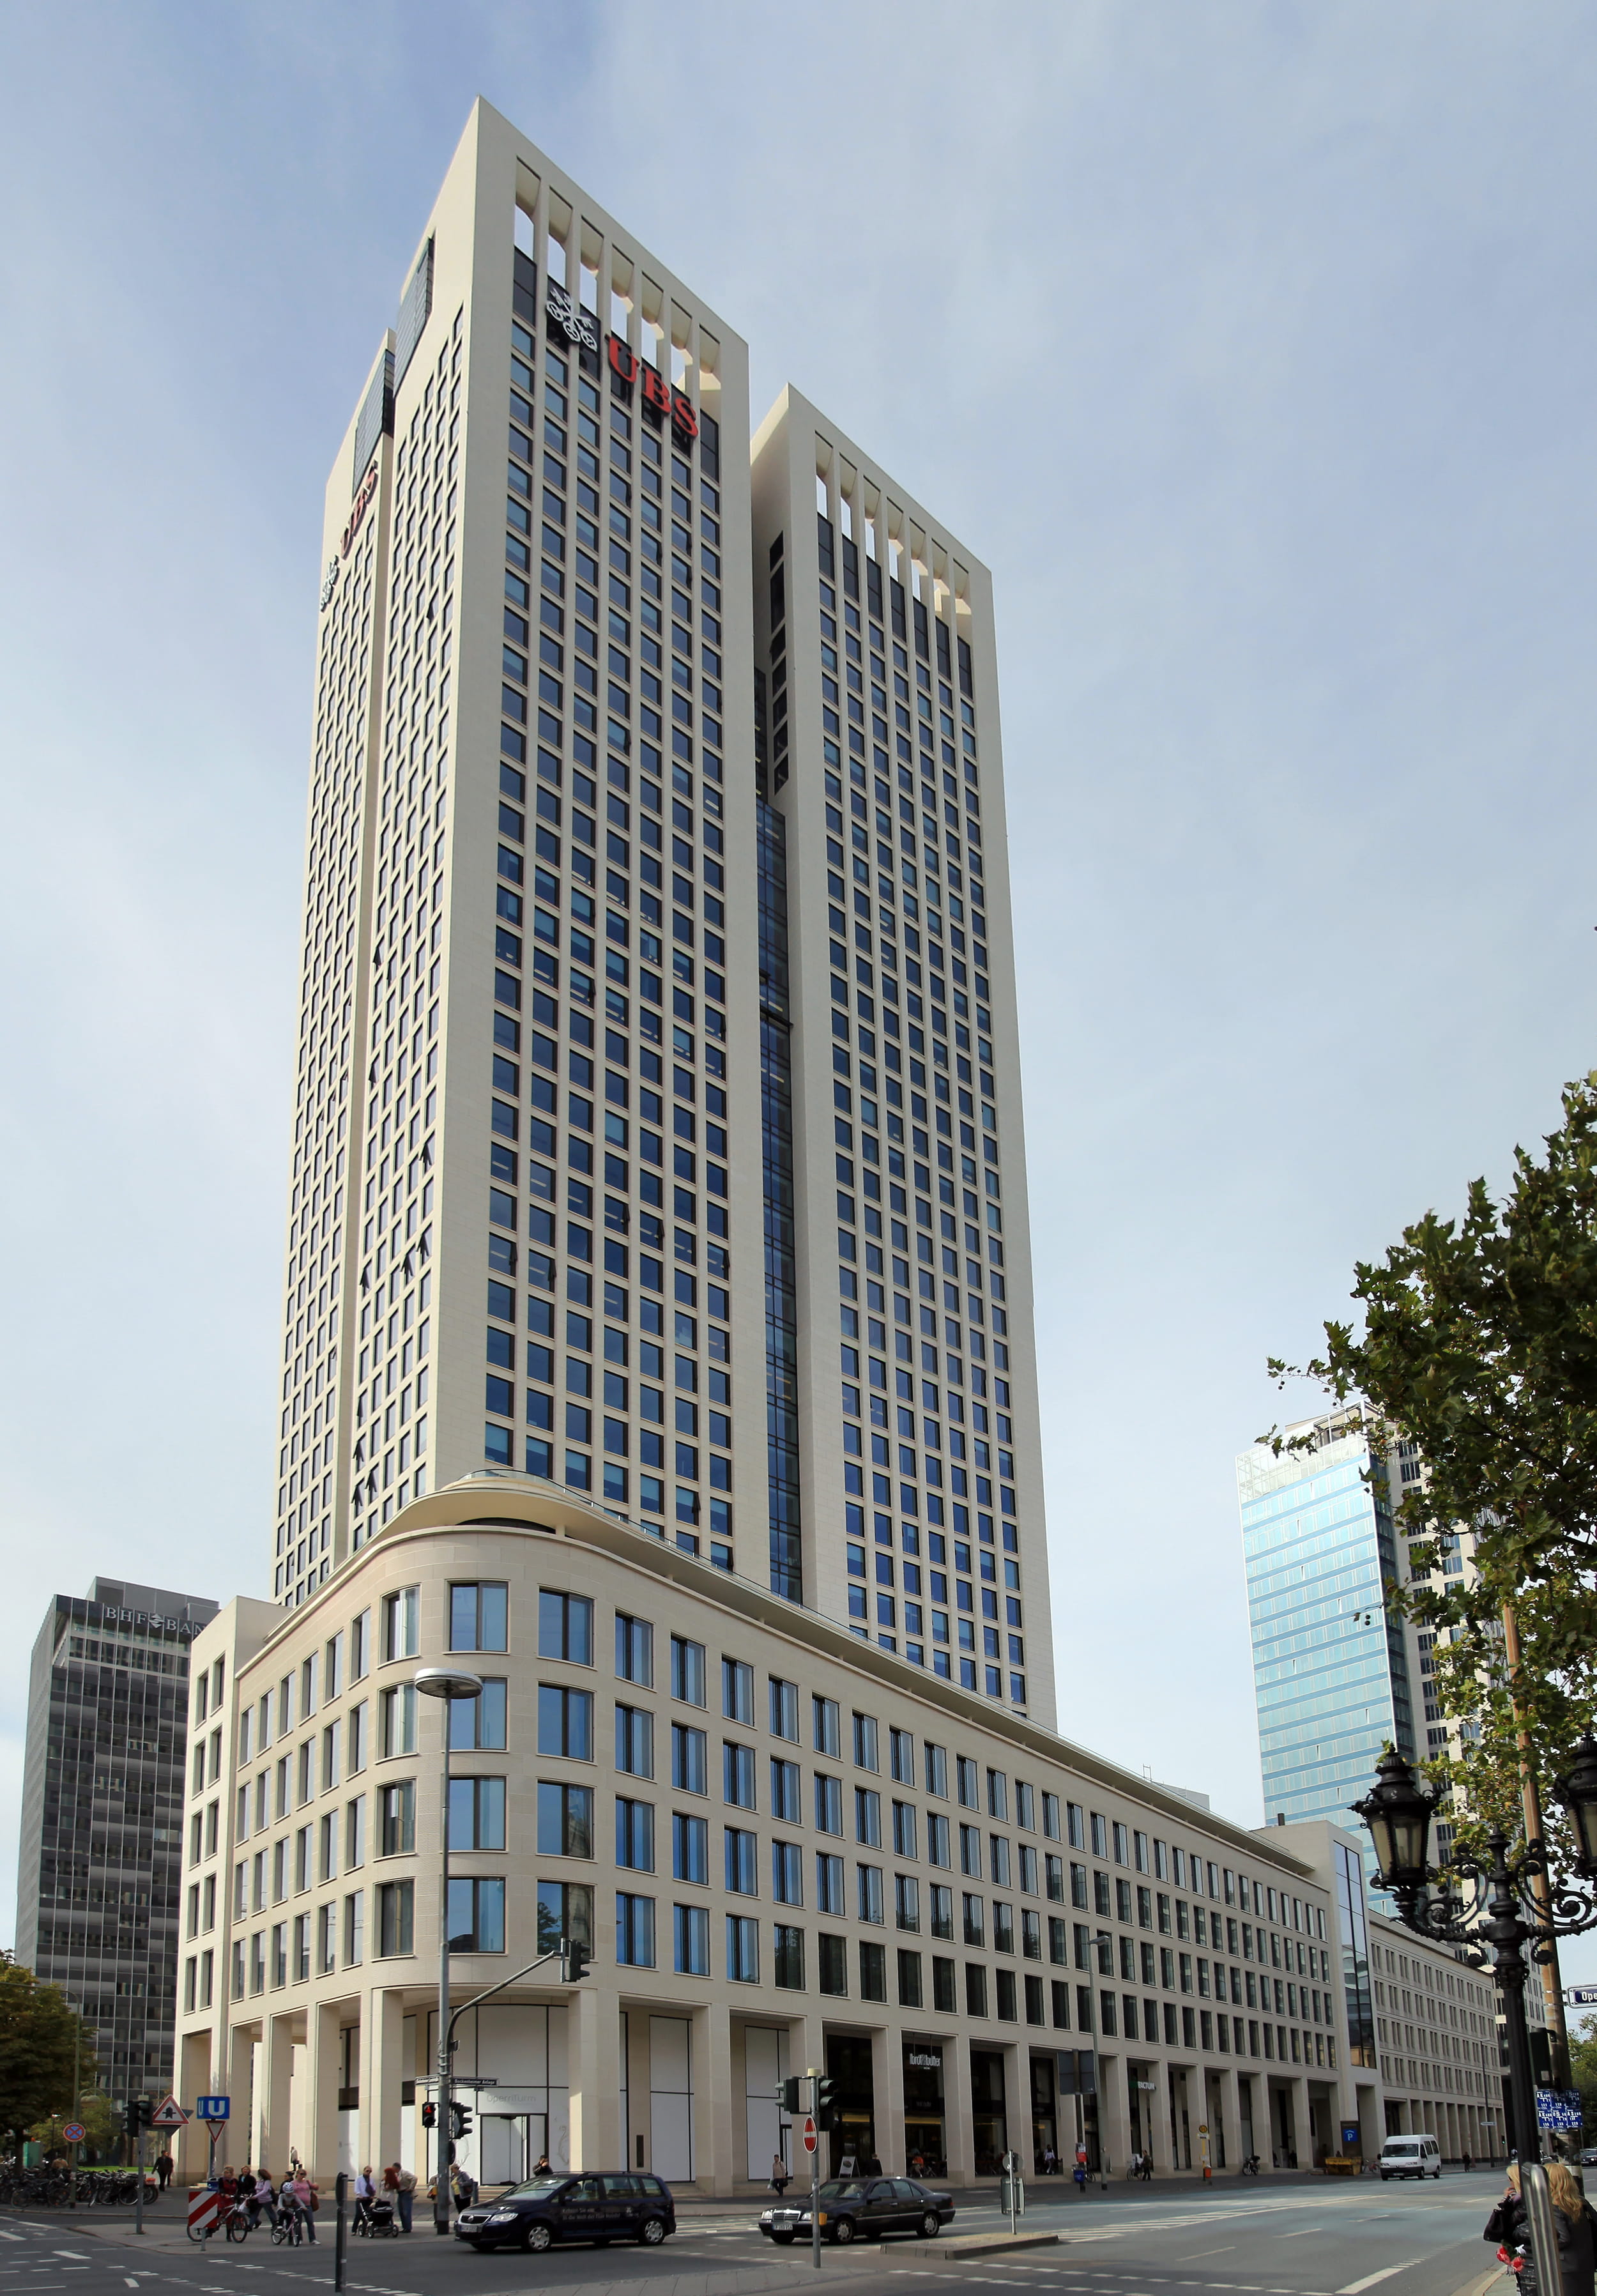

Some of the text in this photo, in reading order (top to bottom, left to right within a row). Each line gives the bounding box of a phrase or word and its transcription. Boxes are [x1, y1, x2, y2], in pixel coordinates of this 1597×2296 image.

[606, 334, 699, 437] UBS
[105, 1607, 206, 1635] BHF BAN
[487, 2093, 537, 2104] OpernTurm
[198, 2100, 204, 2116] U
[208, 2100, 225, 2116] U
